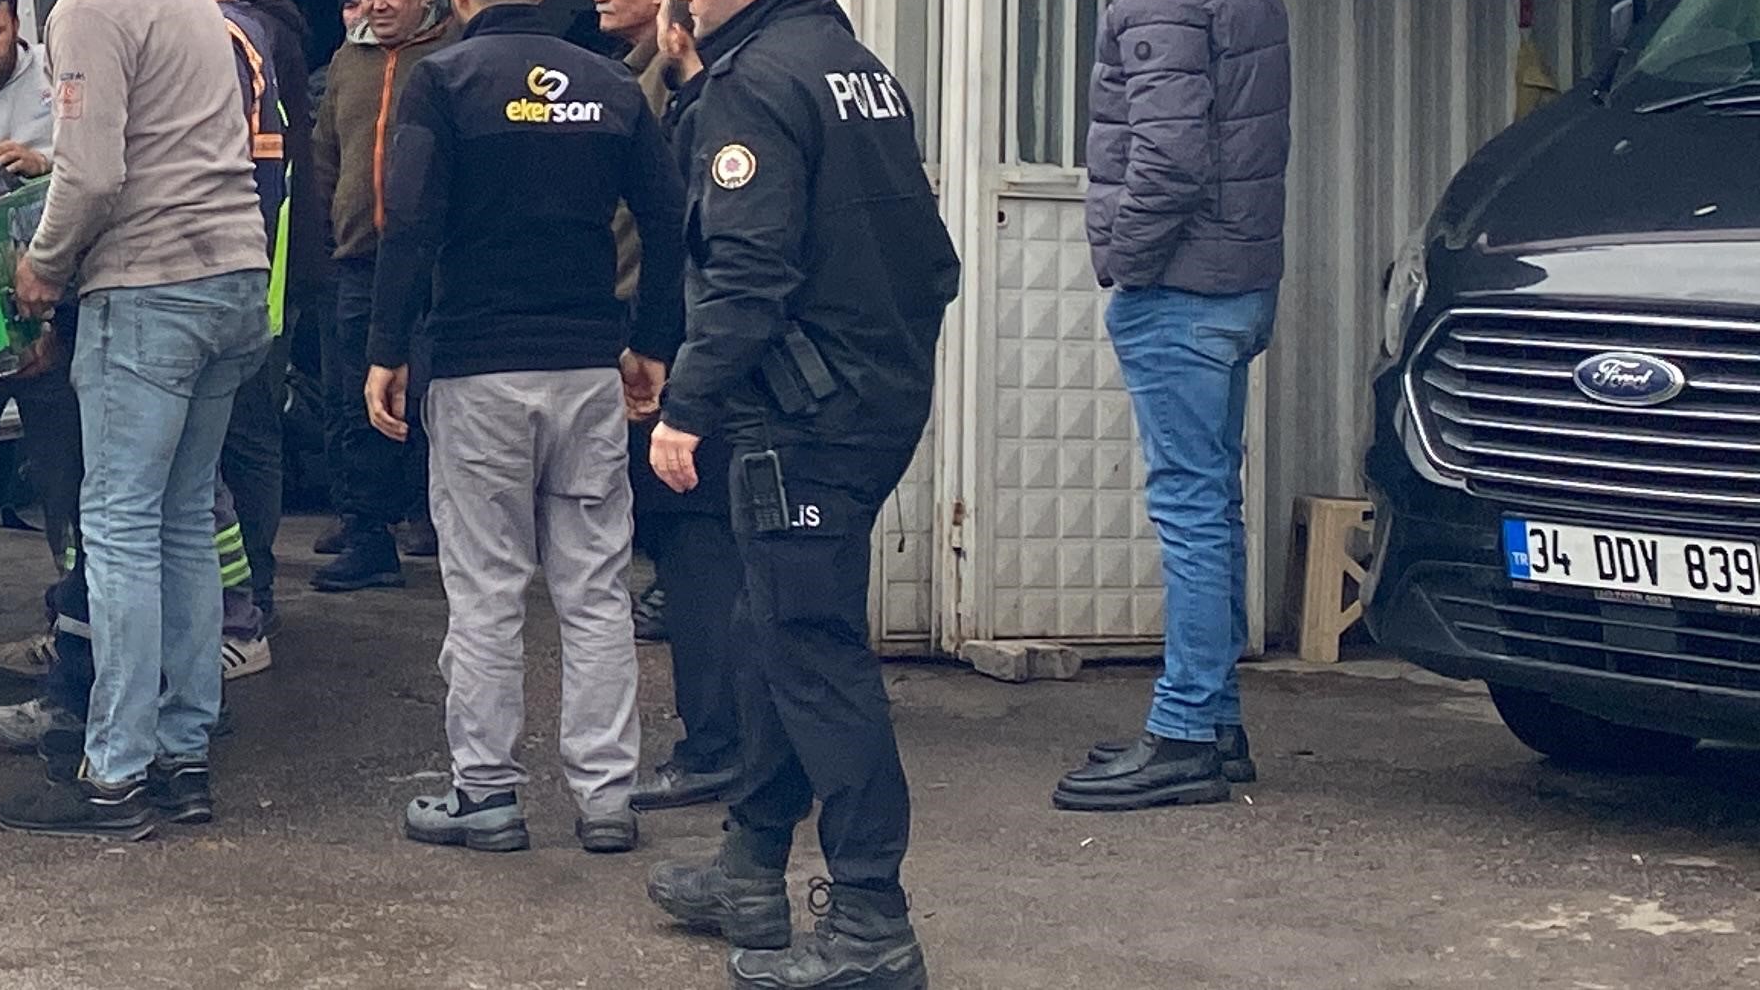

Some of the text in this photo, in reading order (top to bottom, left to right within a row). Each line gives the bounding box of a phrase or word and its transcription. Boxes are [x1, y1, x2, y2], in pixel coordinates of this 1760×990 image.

[505, 98, 600, 123] ekersan
[1592, 358, 1654, 389] Ford
[1511, 528, 1756, 596] TR 34 DDV 839
